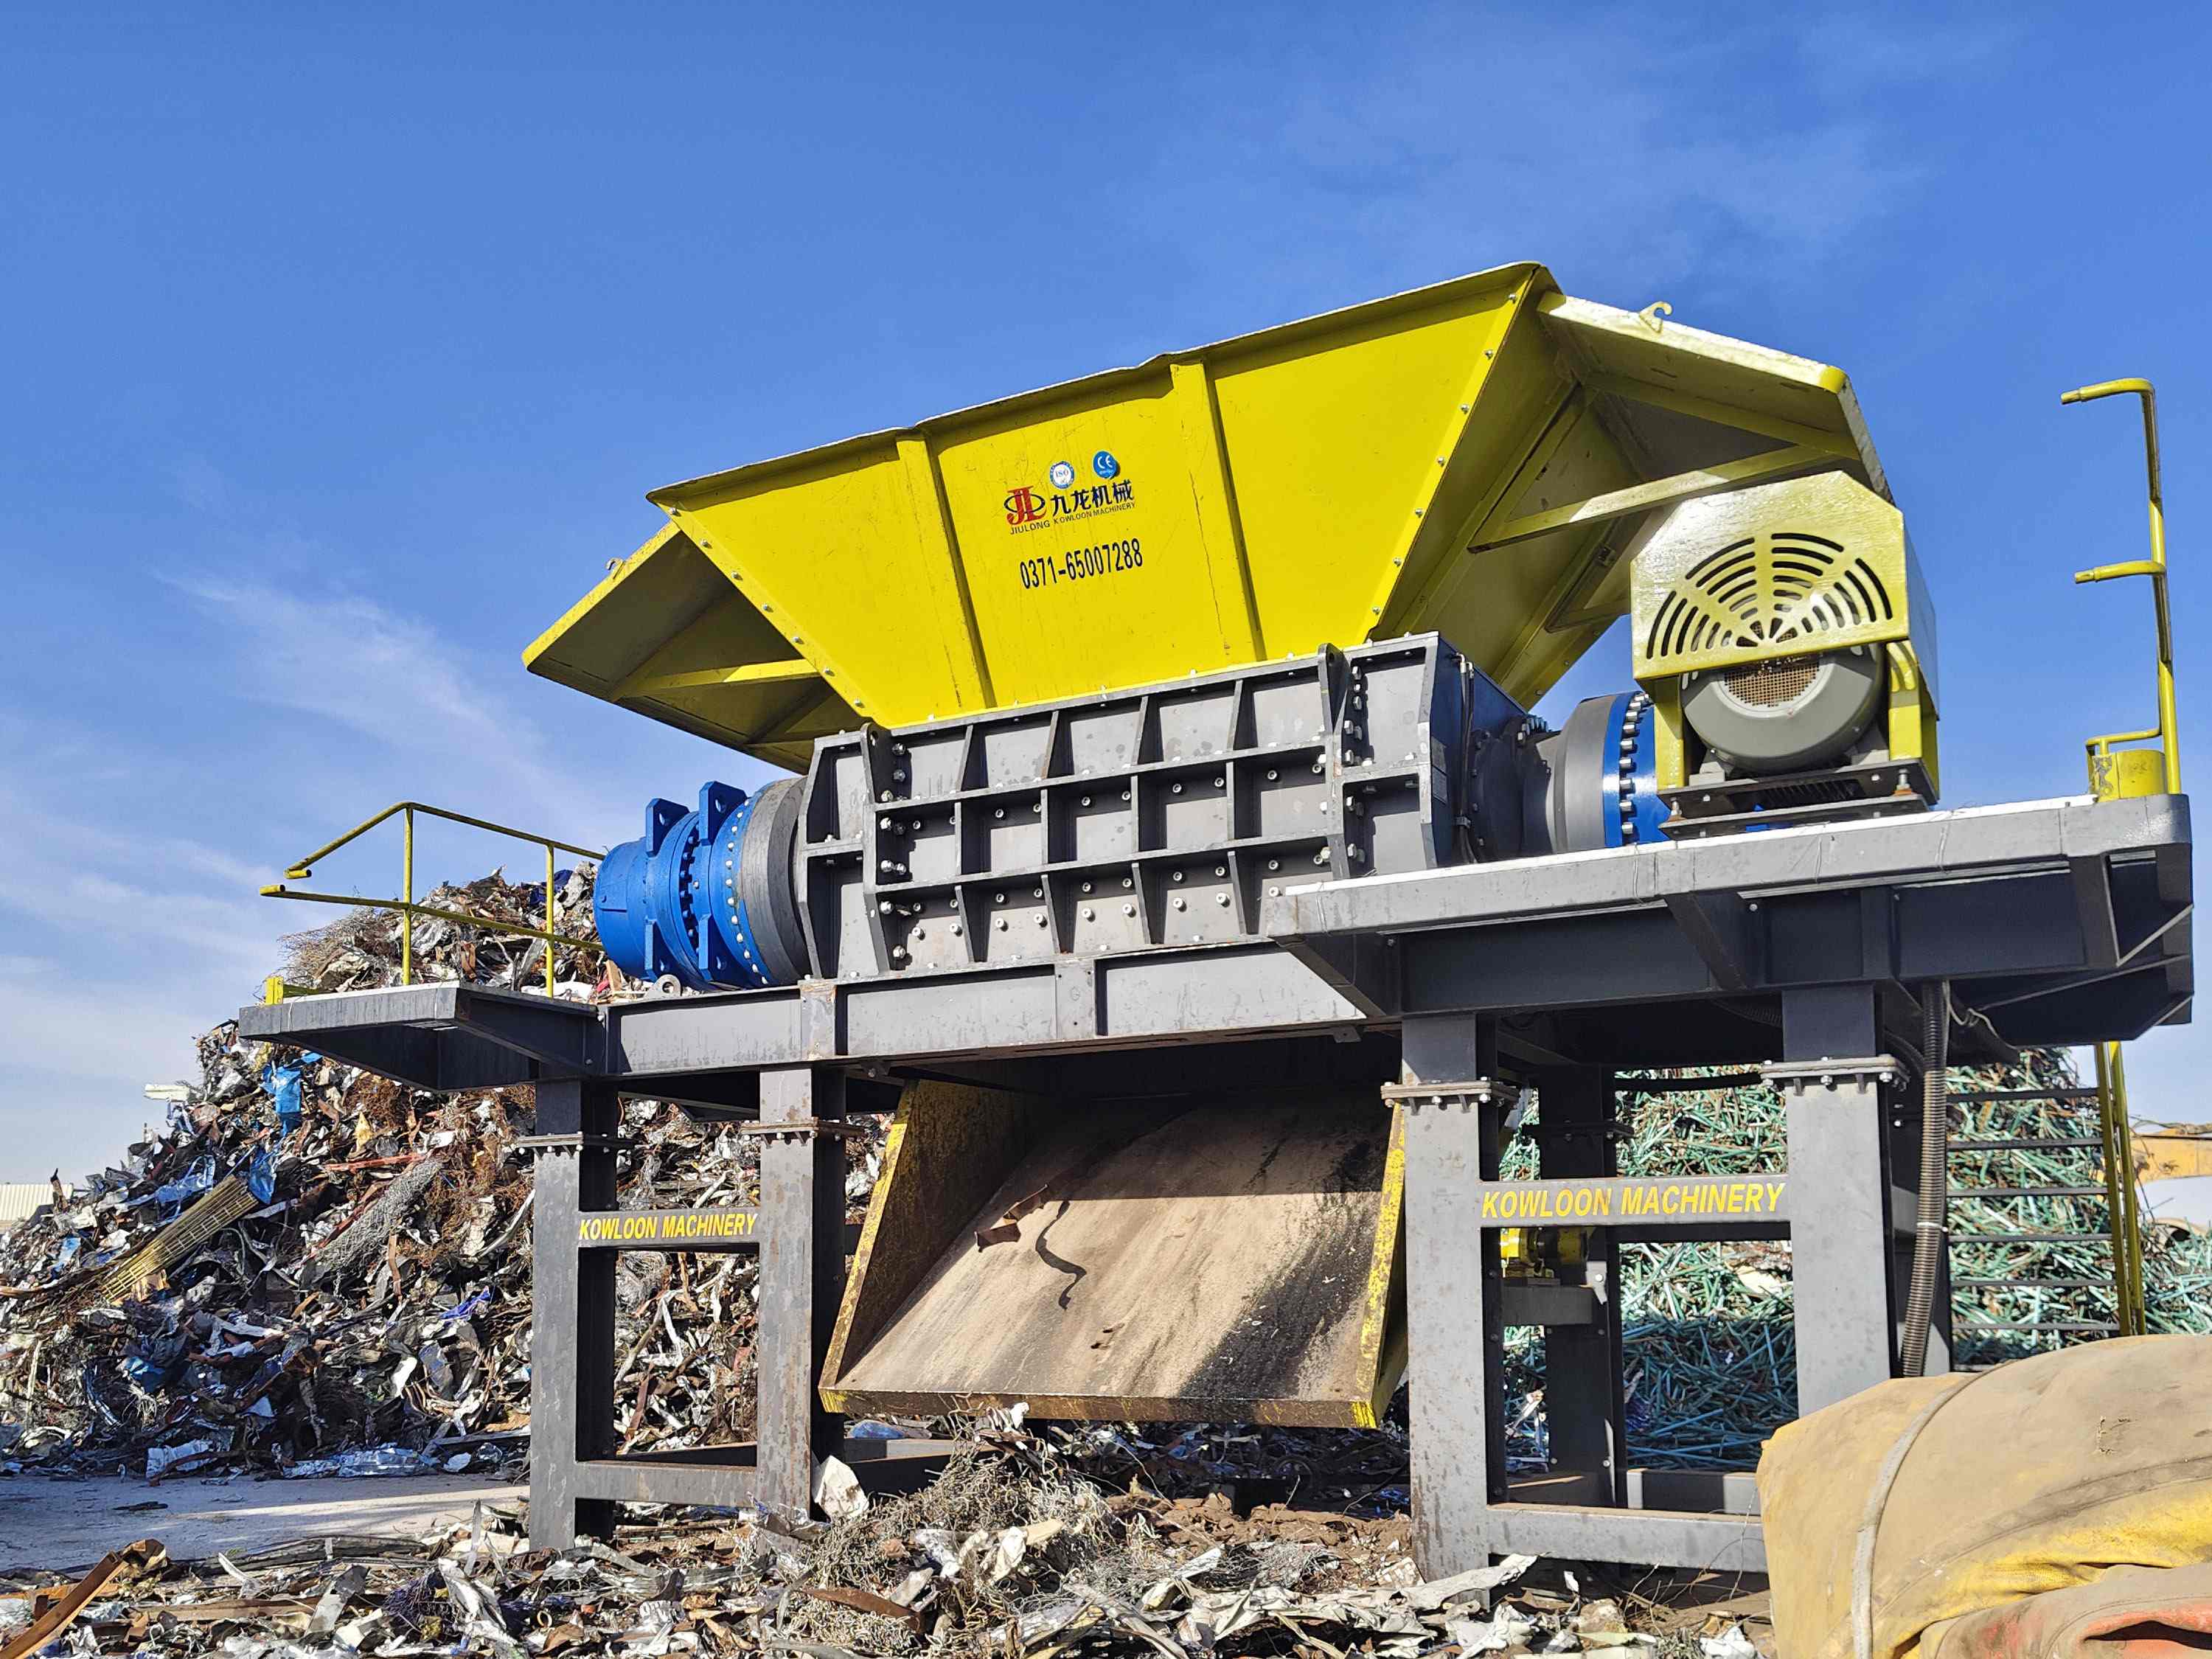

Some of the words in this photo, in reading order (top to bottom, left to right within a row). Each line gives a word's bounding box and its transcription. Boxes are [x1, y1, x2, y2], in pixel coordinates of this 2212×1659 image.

[1050, 479, 1135, 516] 九龙机械
[1010, 520, 1050, 535] JIULONG
[1054, 511, 1092, 524] KOWLOON
[1093, 501, 1135, 516] MACHINERY
[1020, 538, 1142, 588] 0371-65007288
[1481, 1188, 1611, 1218] KOWLOON
[1621, 1183, 1786, 1214] MACHINERY
[579, 1217, 657, 1239] KOWLOON
[661, 1214, 757, 1238] MACHINERY
